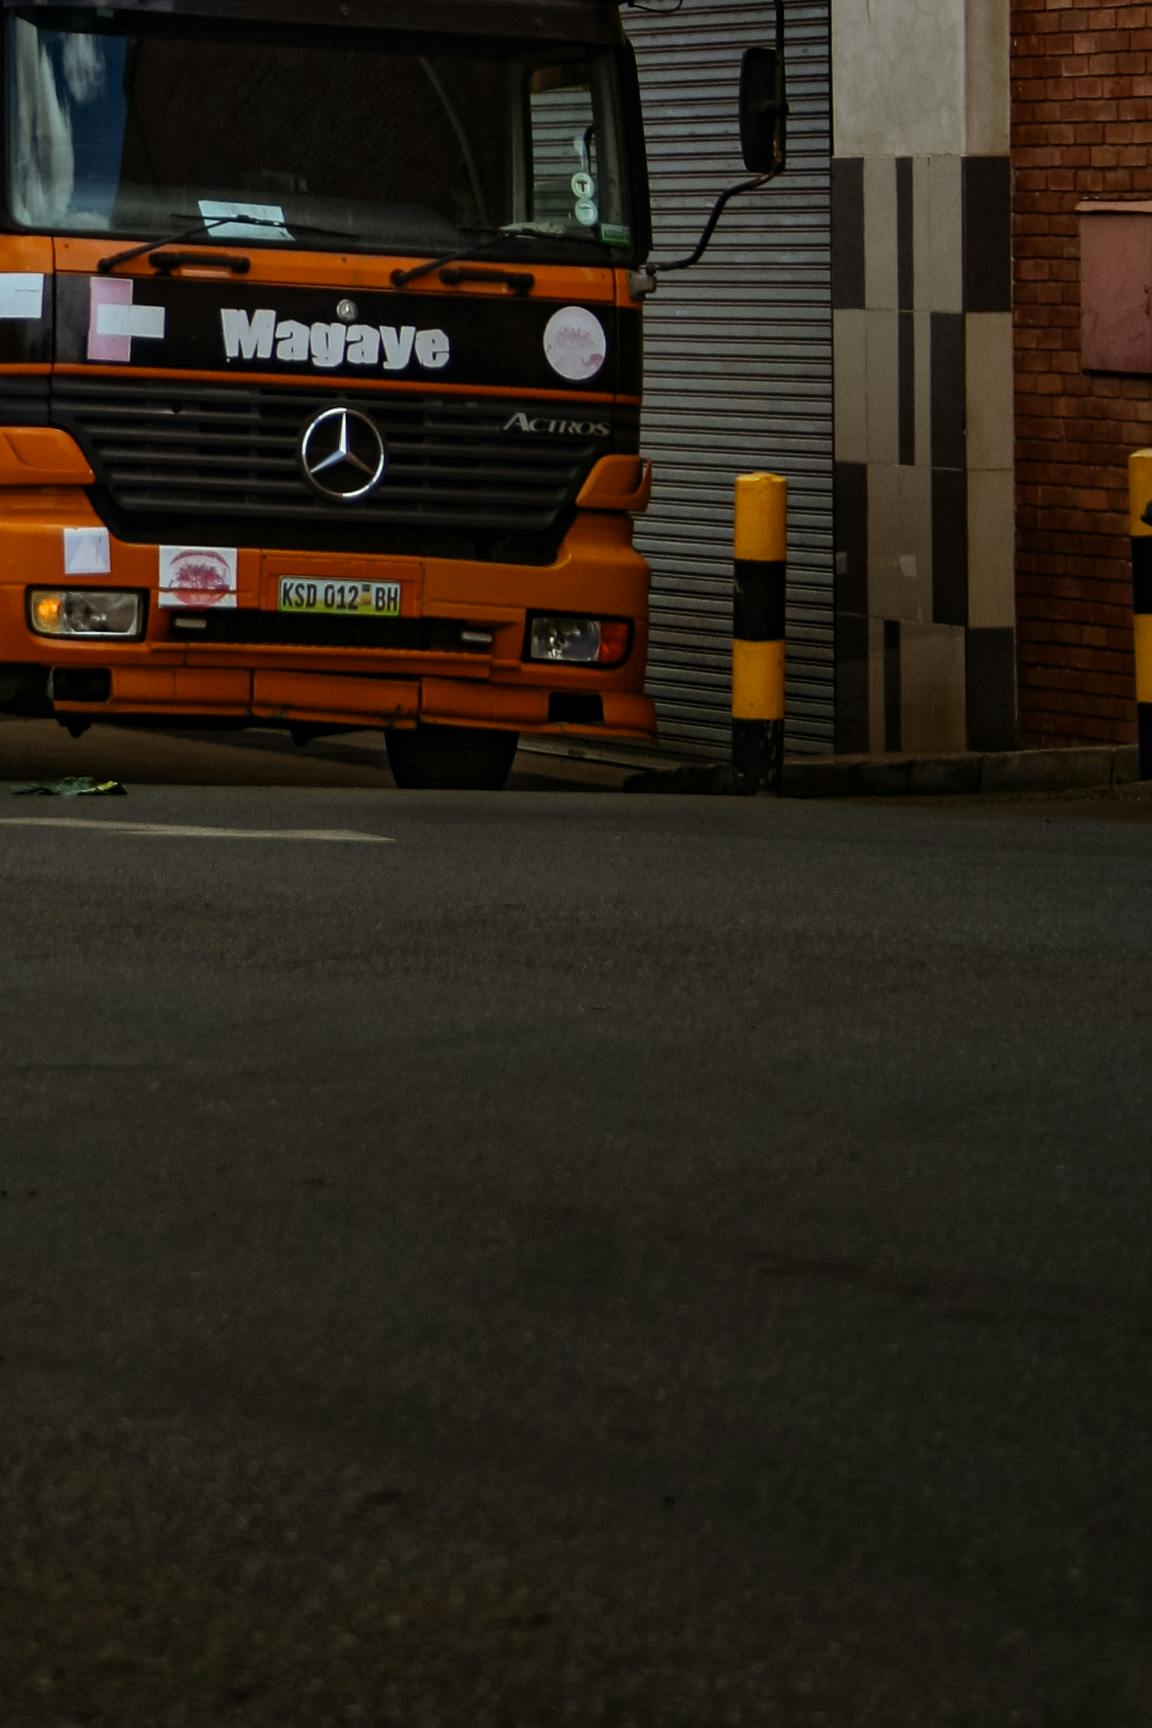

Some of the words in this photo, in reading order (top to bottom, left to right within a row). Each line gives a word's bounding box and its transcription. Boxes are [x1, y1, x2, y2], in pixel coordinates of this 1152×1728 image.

[221, 308, 449, 369] Magaye
[282, 582, 317, 608] KSD
[324, 584, 359, 610] 012
[375, 586, 399, 611] BH
